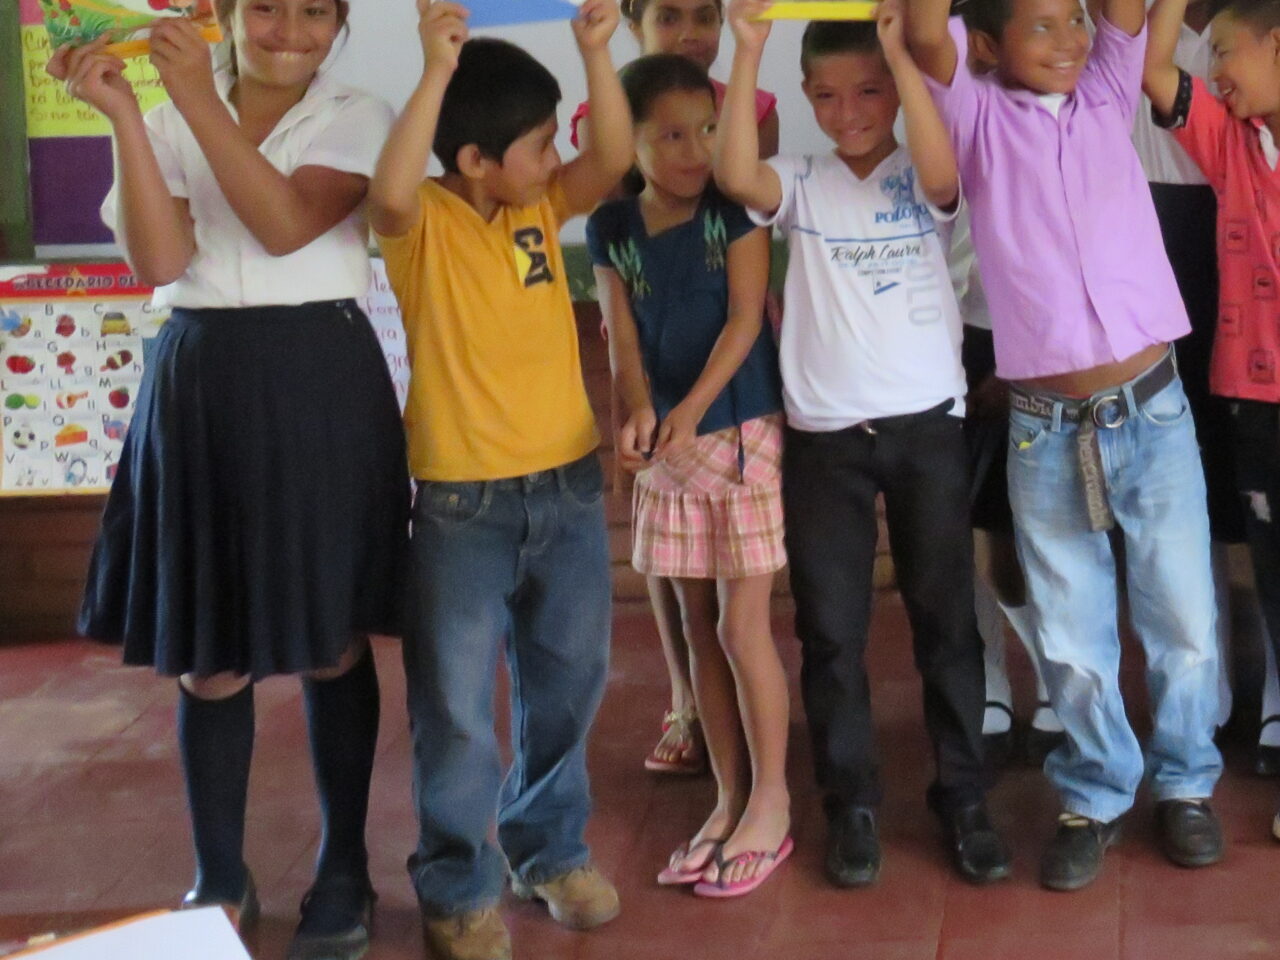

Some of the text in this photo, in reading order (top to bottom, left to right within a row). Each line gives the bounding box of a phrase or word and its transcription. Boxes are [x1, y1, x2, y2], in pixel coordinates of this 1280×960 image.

[45, 304, 54, 316] B
[96, 341, 107, 351] H
[99, 378, 111, 389] M
[4, 416, 12, 427] P
[6, 450, 113, 464] V W X
